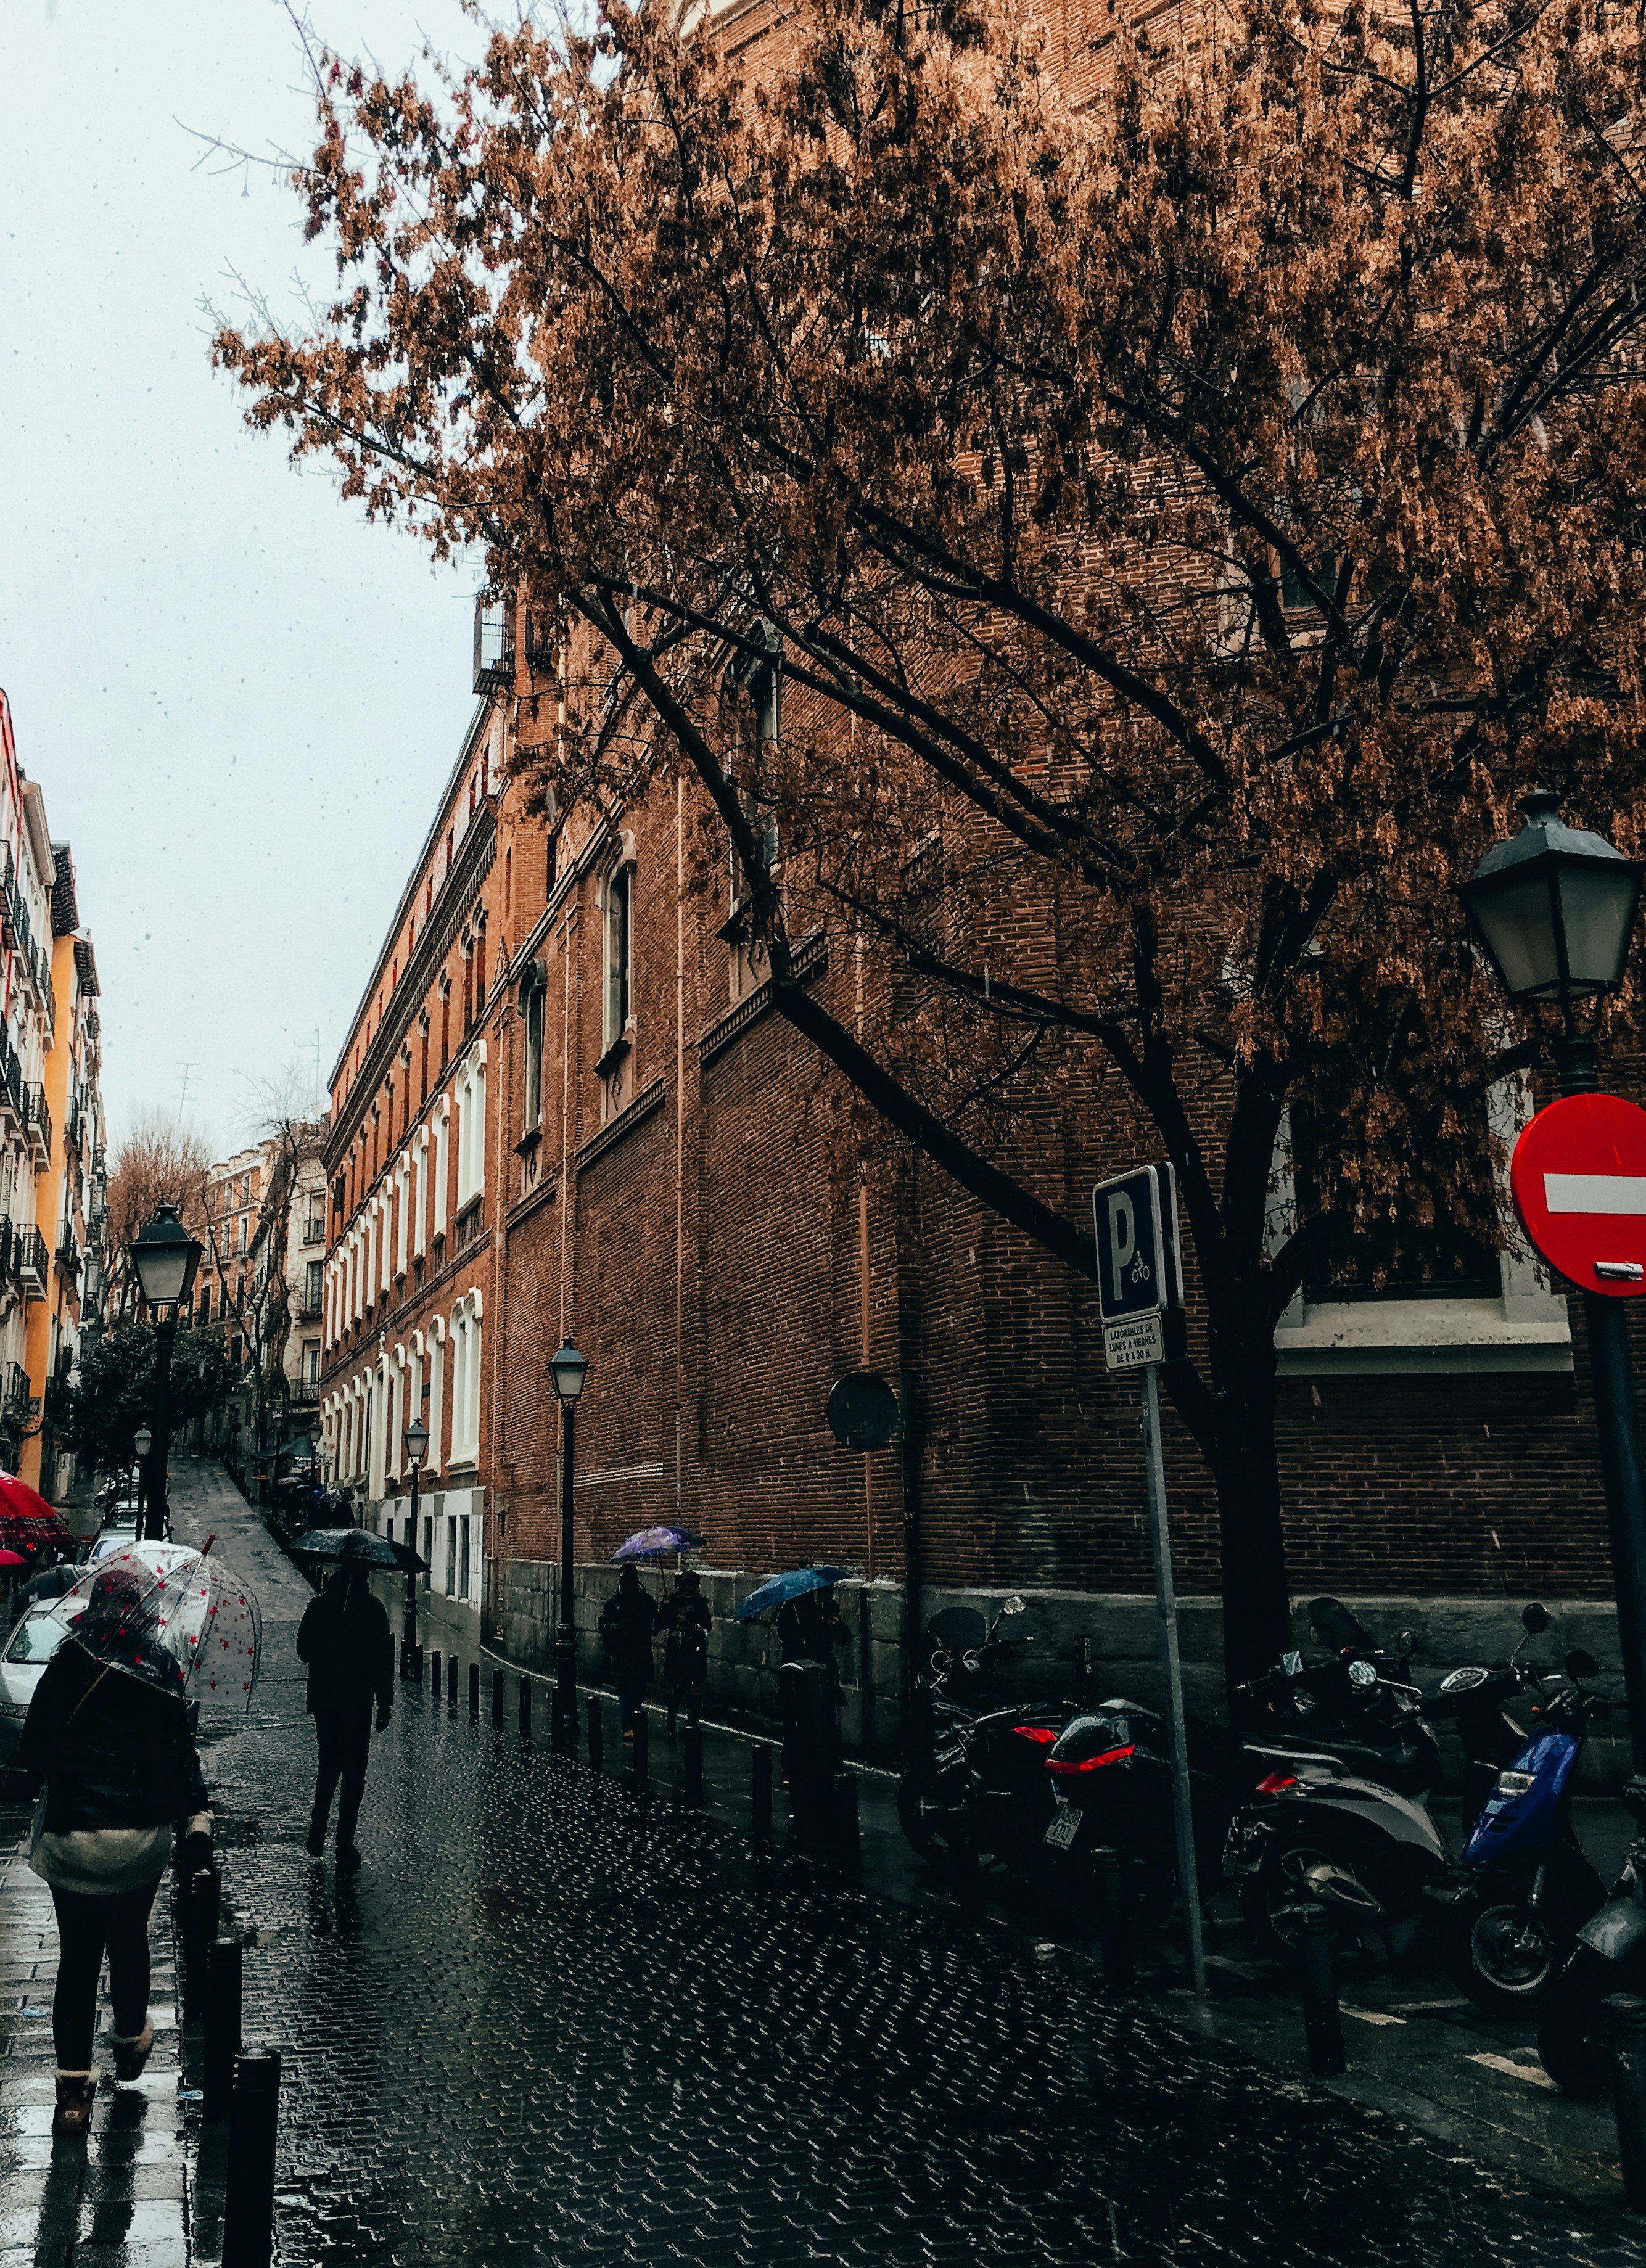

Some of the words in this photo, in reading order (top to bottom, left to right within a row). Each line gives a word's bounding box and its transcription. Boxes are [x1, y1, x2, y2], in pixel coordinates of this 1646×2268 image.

[1108, 1191, 1135, 1300] P
[1110, 1325, 1143, 1341] LABORABLES
[1145, 1323, 1153, 1333] DE
[1109, 1341, 1126, 1352] LUNES
[1129, 1339, 1132, 1349] A
[1133, 1334, 1156, 1348] VIERNES
[1116, 1354, 1124, 1363] DE
[1132, 1352, 1135, 1360] A
[1136, 1349, 1144, 1360] 20
